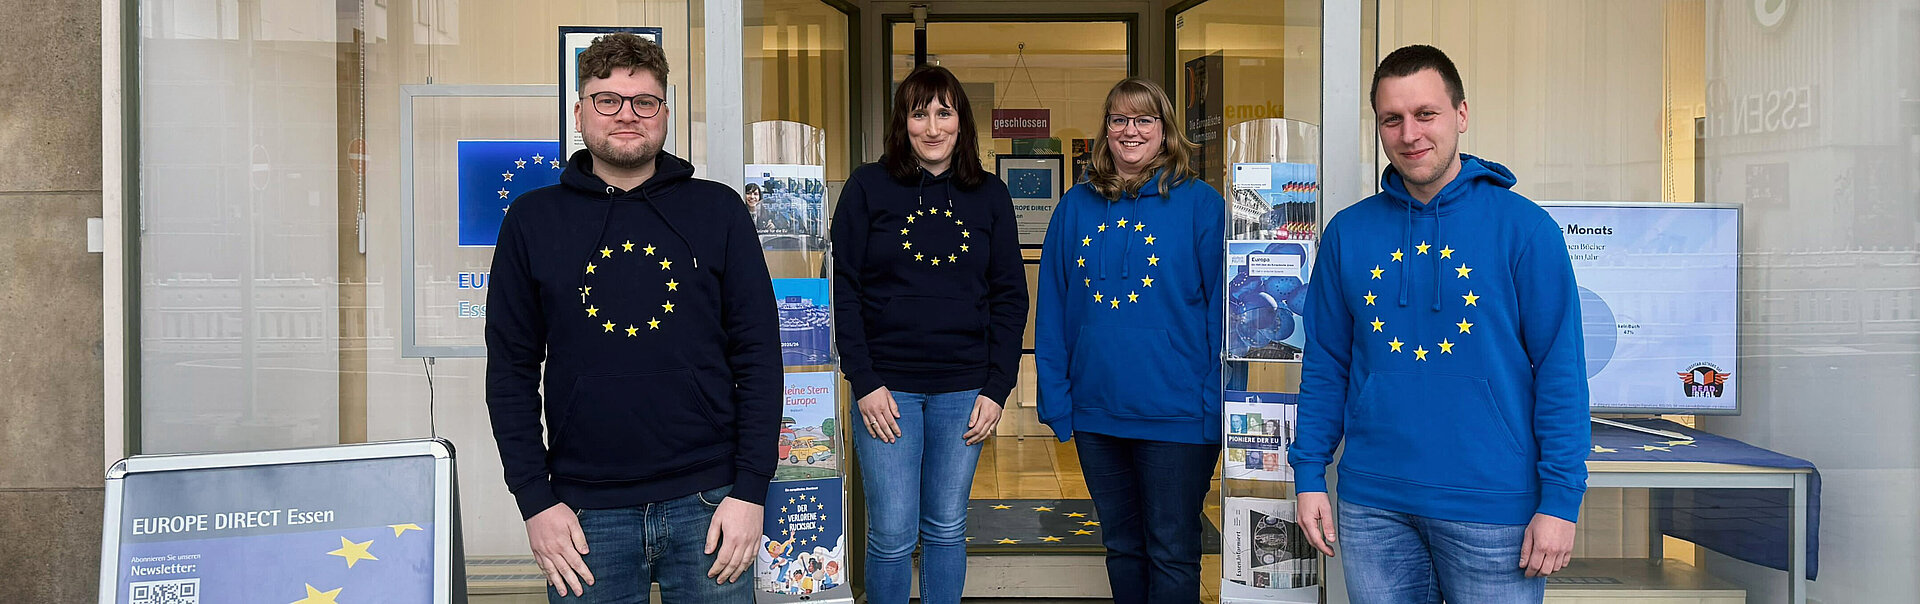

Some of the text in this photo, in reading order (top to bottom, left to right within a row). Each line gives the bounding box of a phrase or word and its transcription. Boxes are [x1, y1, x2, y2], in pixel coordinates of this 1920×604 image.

[994, 117, 1047, 130] geschlossen
[1567, 224, 1613, 235] Monats
[457, 272, 490, 289] EU
[807, 385, 829, 395] Stern
[786, 397, 817, 407] Europa
[797, 504, 808, 513] DER
[132, 508, 335, 535] EUROPE DIRECT Essen
[787, 512, 817, 522] VERLORENE
[789, 521, 817, 532] RUCKSACK
[131, 555, 166, 563] Abonnieren
[177, 553, 201, 561] unseren
[131, 563, 196, 577] Newsletter:
